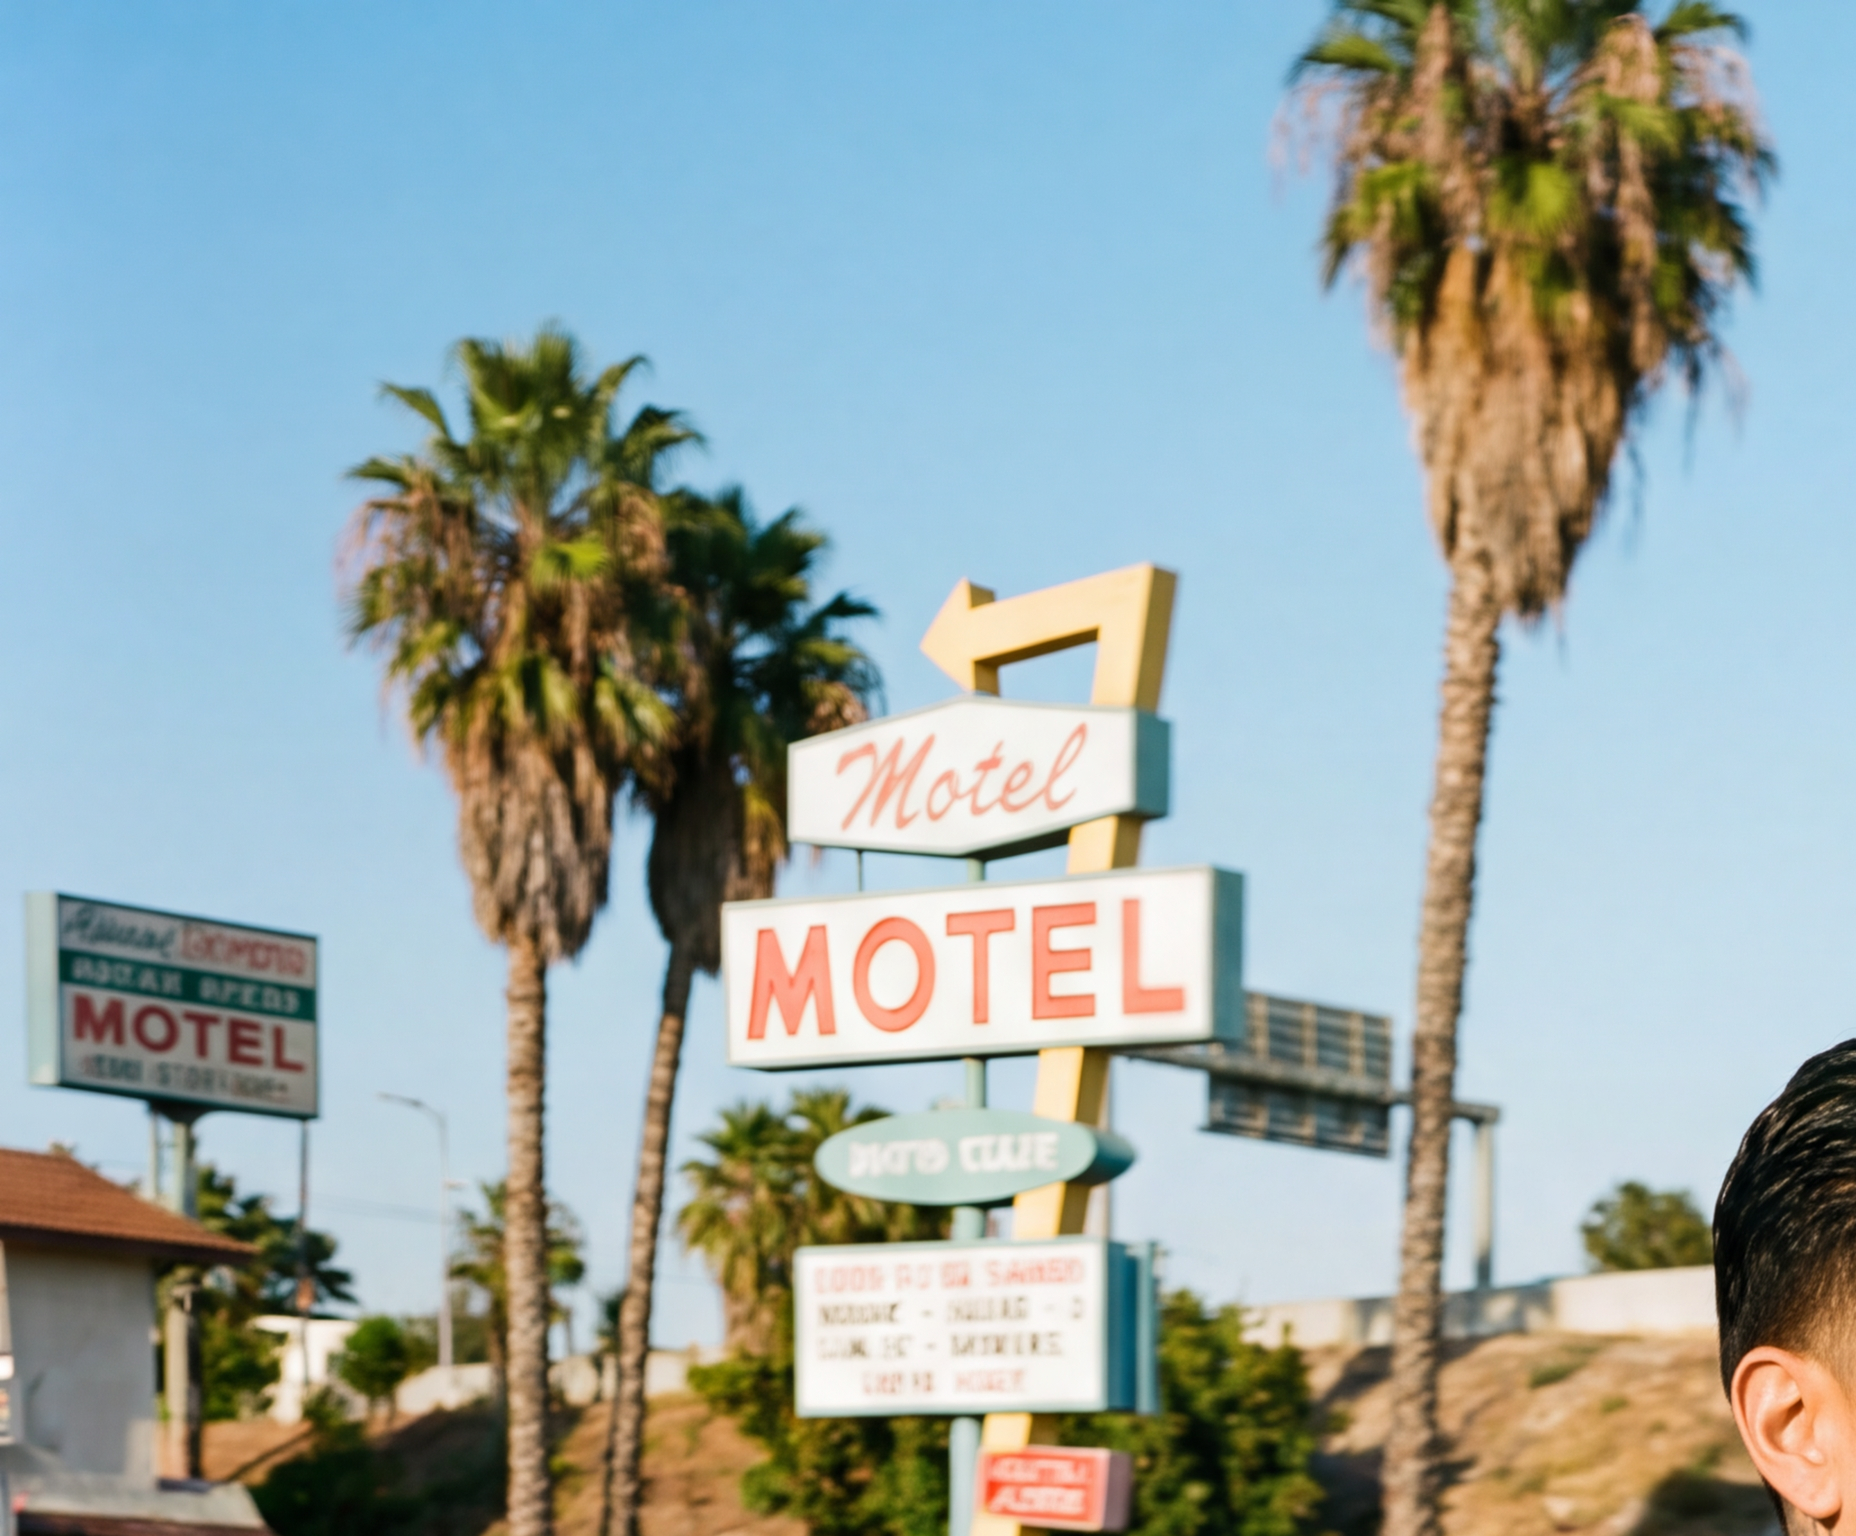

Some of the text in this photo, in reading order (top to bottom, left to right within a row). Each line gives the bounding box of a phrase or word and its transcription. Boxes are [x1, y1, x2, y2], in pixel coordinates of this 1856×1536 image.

[836, 722, 1087, 831] Motel
[747, 898, 1185, 1040] MOTEL
[72, 992, 306, 1073] MOTEL
